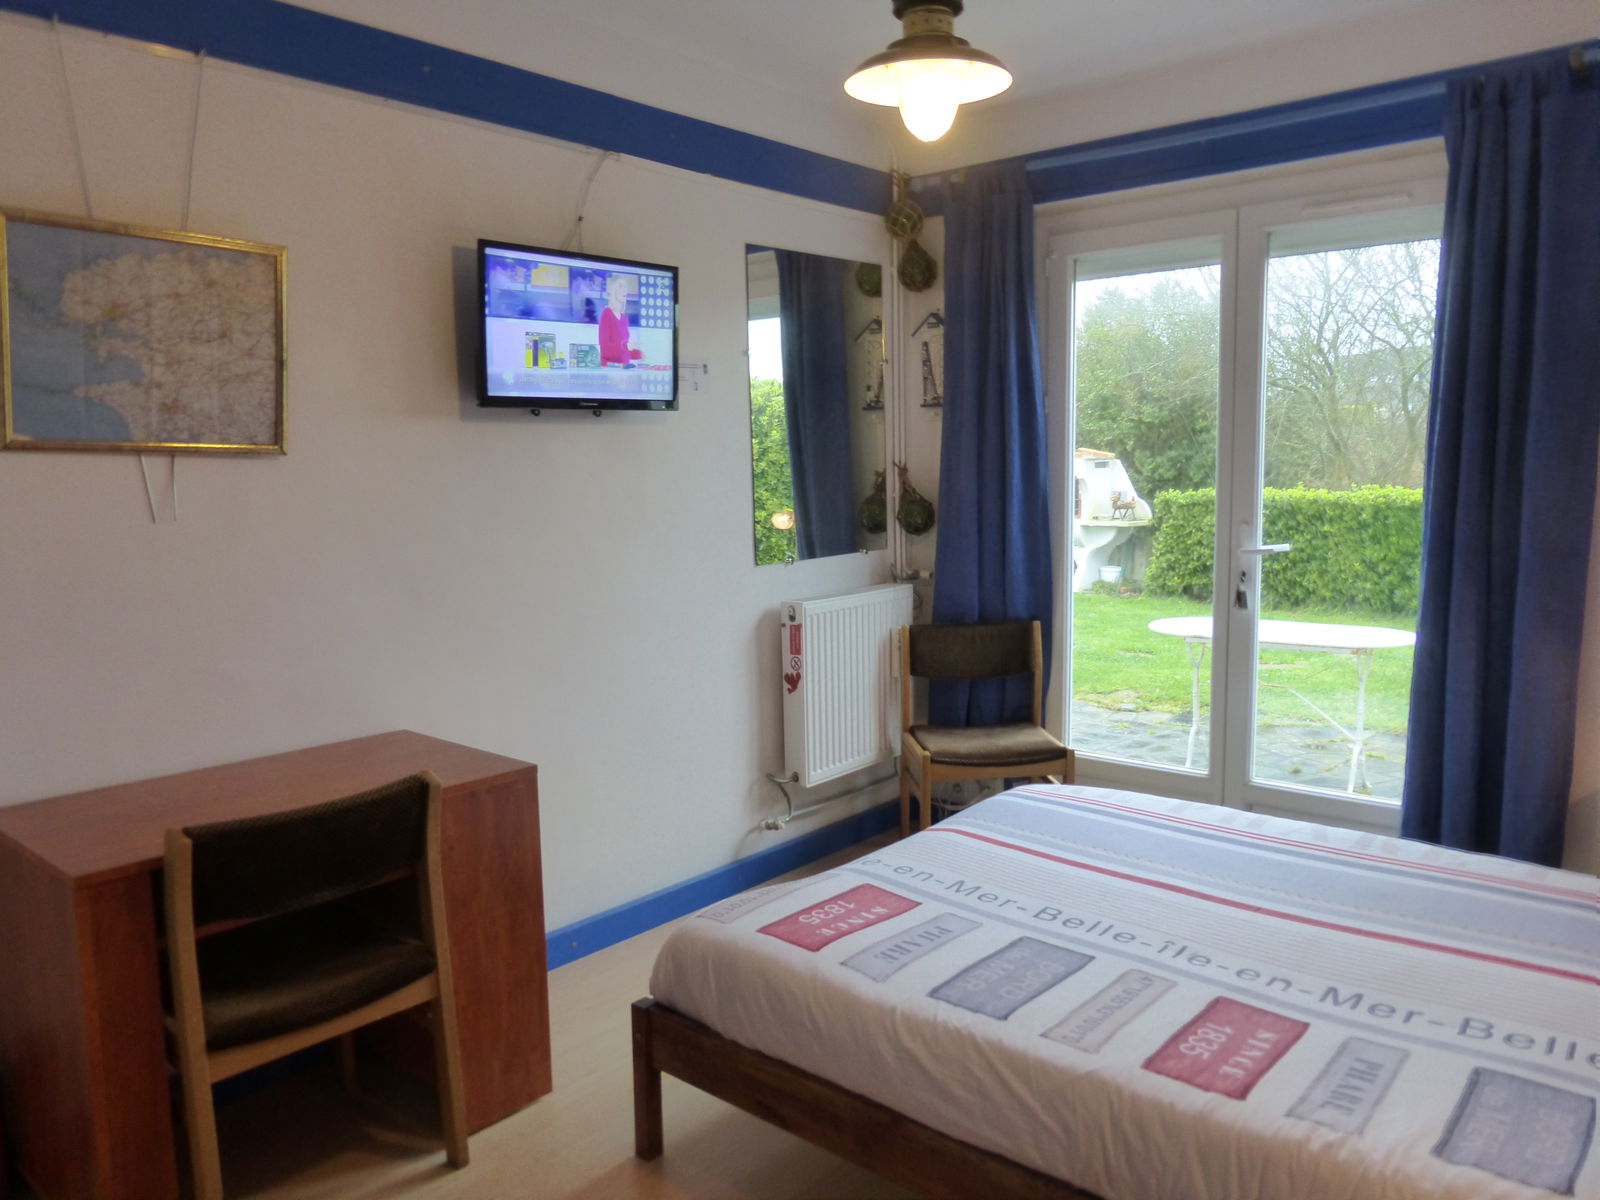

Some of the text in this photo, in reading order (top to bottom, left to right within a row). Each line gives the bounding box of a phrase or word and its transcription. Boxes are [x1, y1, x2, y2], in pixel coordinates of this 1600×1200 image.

[799, 900, 855, 925] 1835
[816, 906, 889, 936] SINCE
[873, 925, 953, 964] PHARE
[1179, 1021, 1233, 1060] 1835
[1219, 1029, 1277, 1078] SINCE
[1319, 1057, 1384, 1116] PHARE
